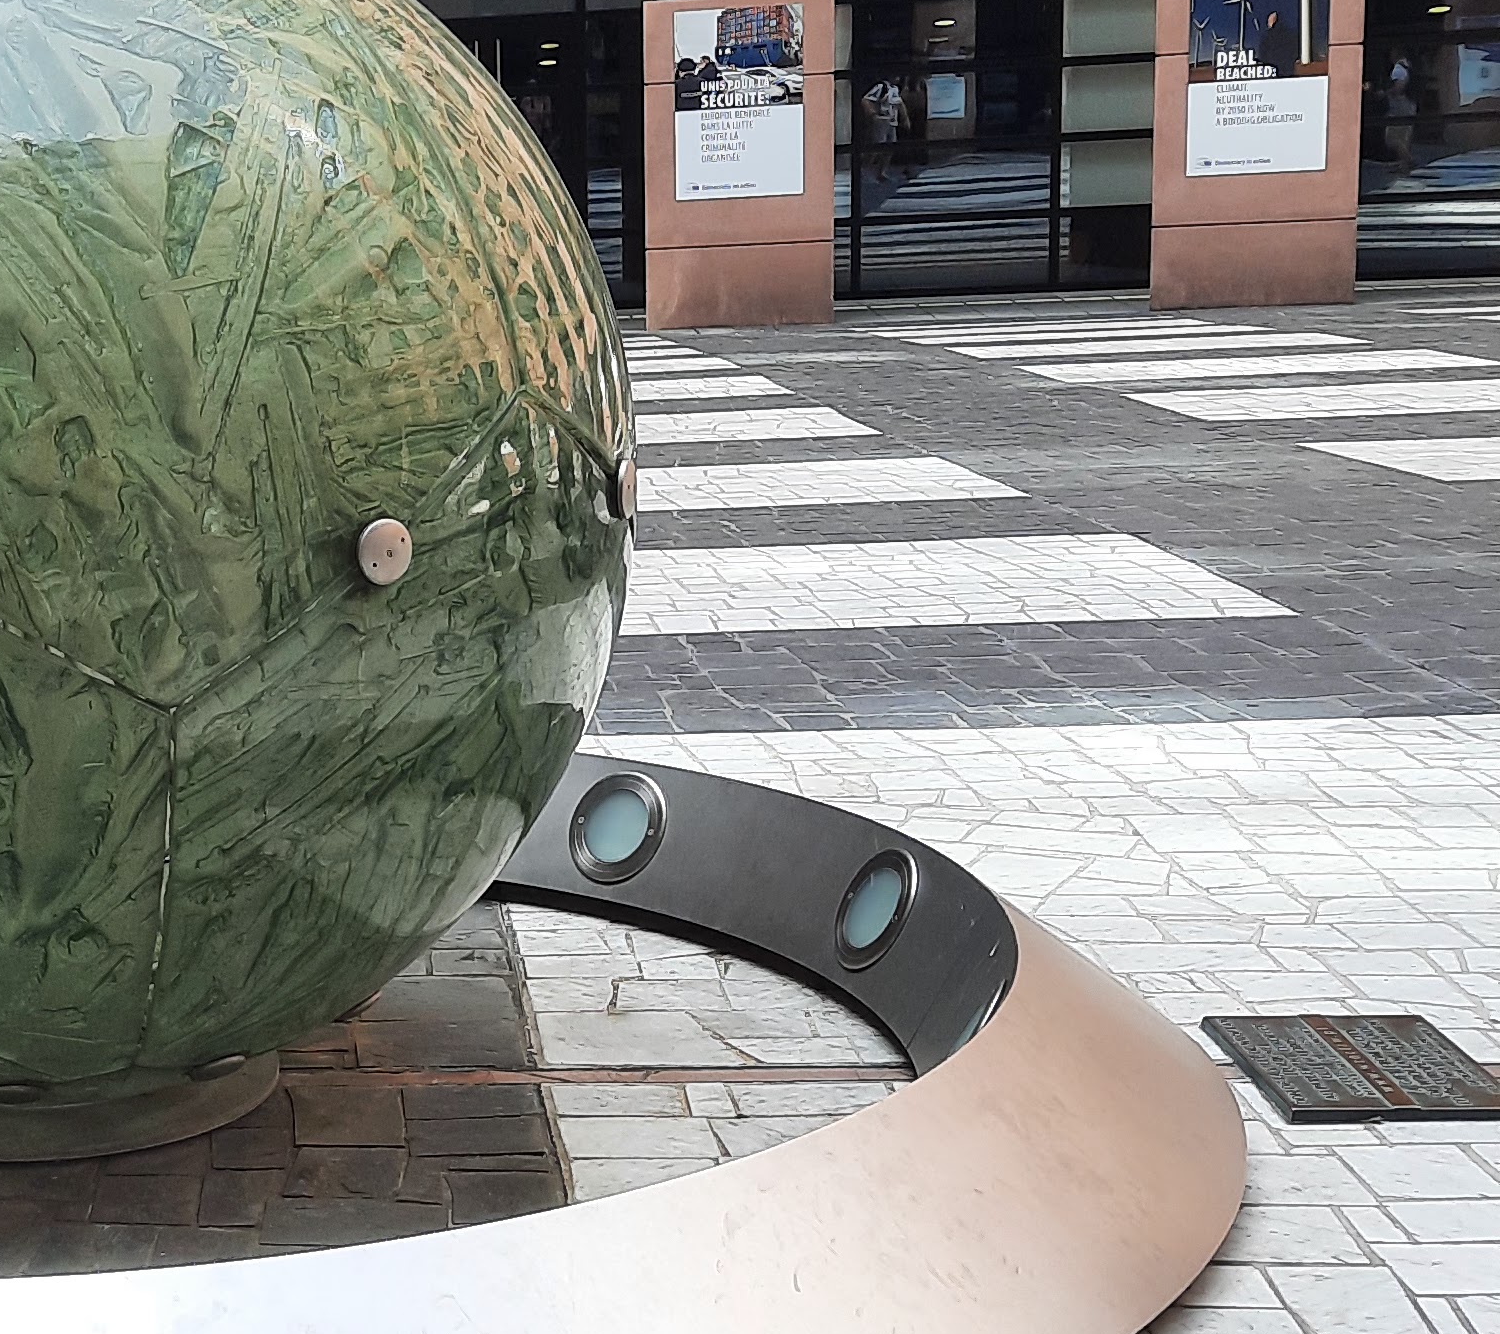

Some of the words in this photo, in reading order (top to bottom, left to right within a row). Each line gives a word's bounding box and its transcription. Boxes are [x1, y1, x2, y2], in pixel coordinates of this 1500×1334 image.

[1216, 49, 1257, 67] DEAL
[700, 79, 726, 92] UNIS
[727, 78, 755, 91] POUR
